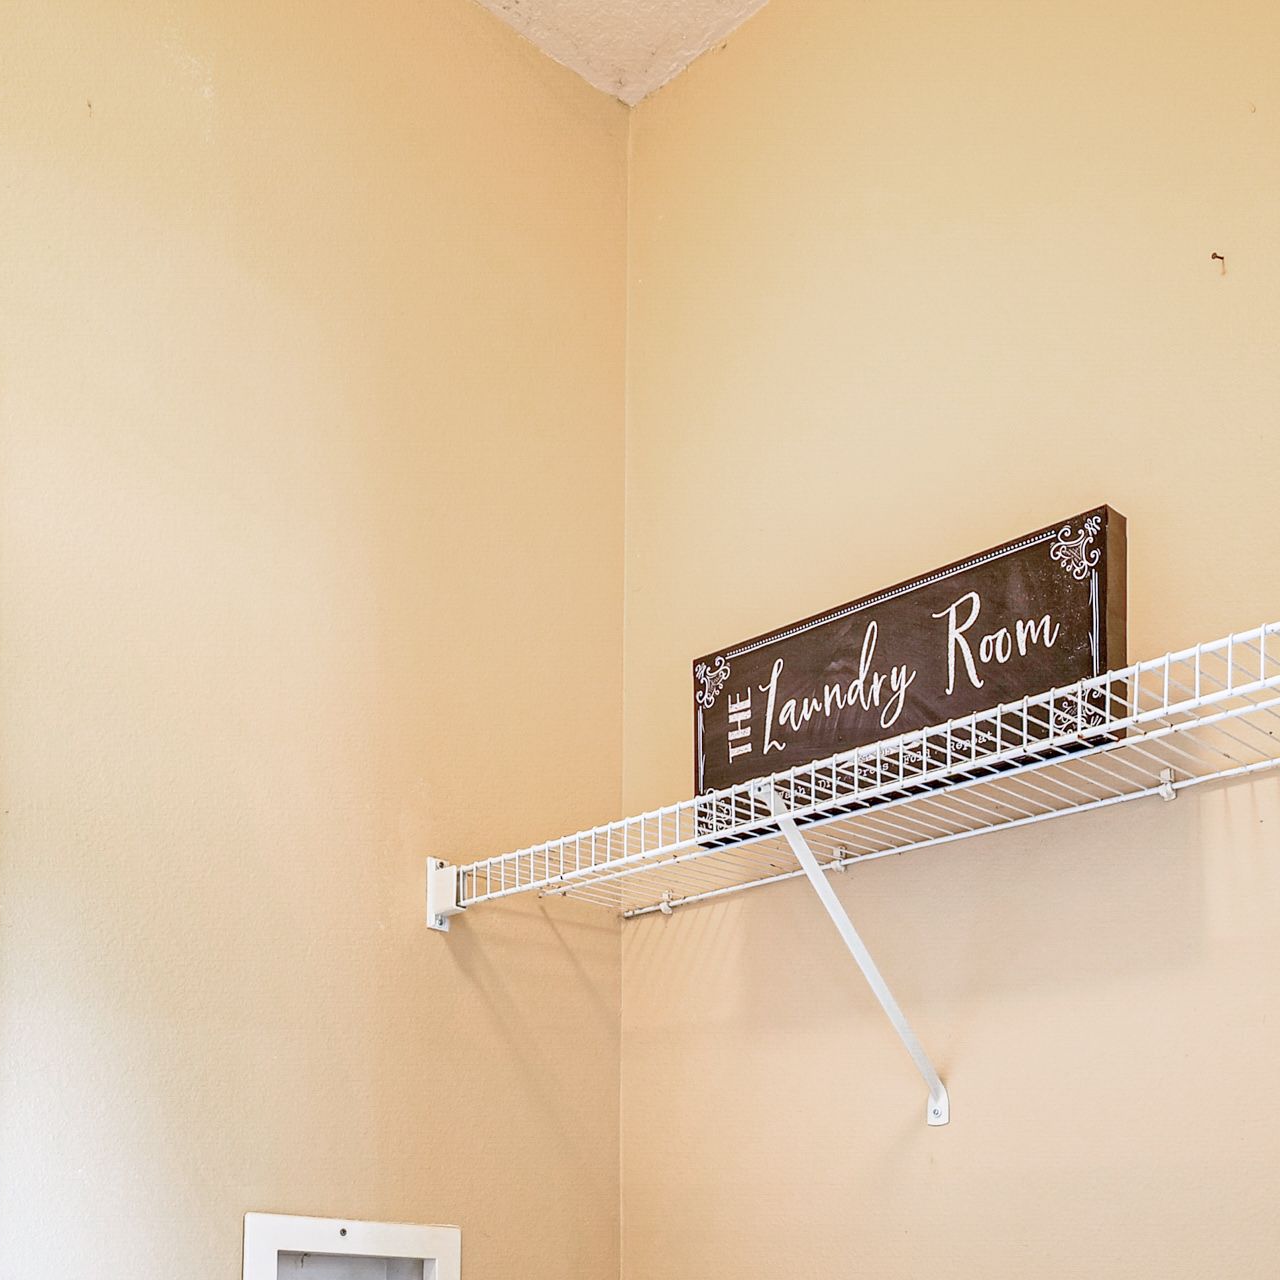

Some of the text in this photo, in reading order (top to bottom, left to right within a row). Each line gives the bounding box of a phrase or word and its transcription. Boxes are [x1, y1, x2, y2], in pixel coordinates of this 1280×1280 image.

[727, 590, 1061, 763] THE Laundry Room
